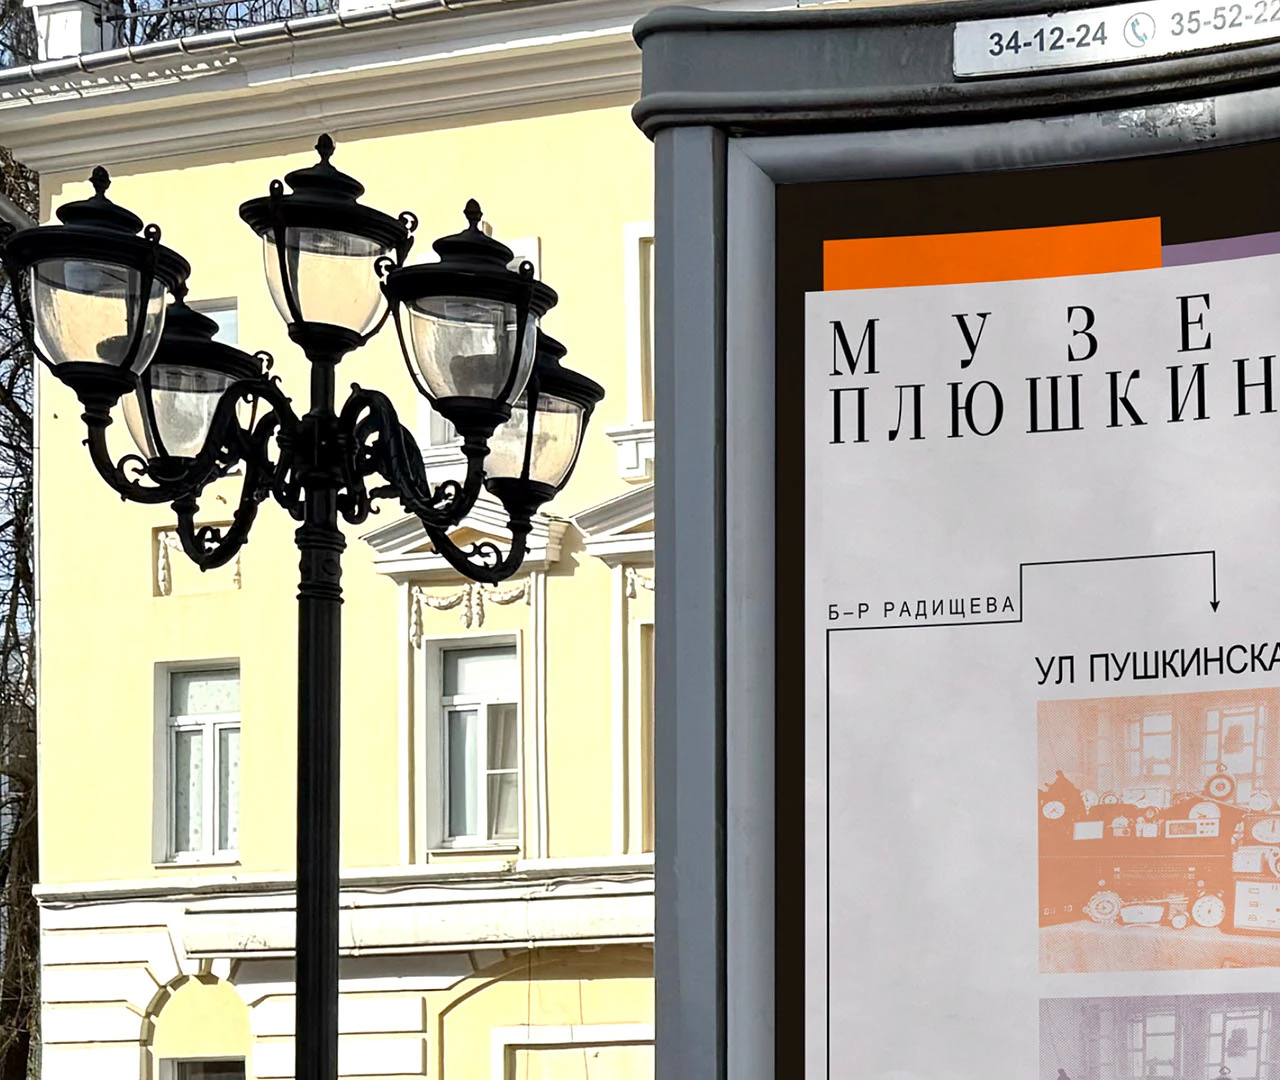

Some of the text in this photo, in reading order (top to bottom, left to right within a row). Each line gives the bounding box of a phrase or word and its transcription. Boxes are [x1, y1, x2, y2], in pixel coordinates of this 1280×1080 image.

[988, 21, 1108, 57] 34-12-24
[883, 595, 1015, 620] РАДИЩЕВА
[1034, 655, 1075, 686] УЛ
